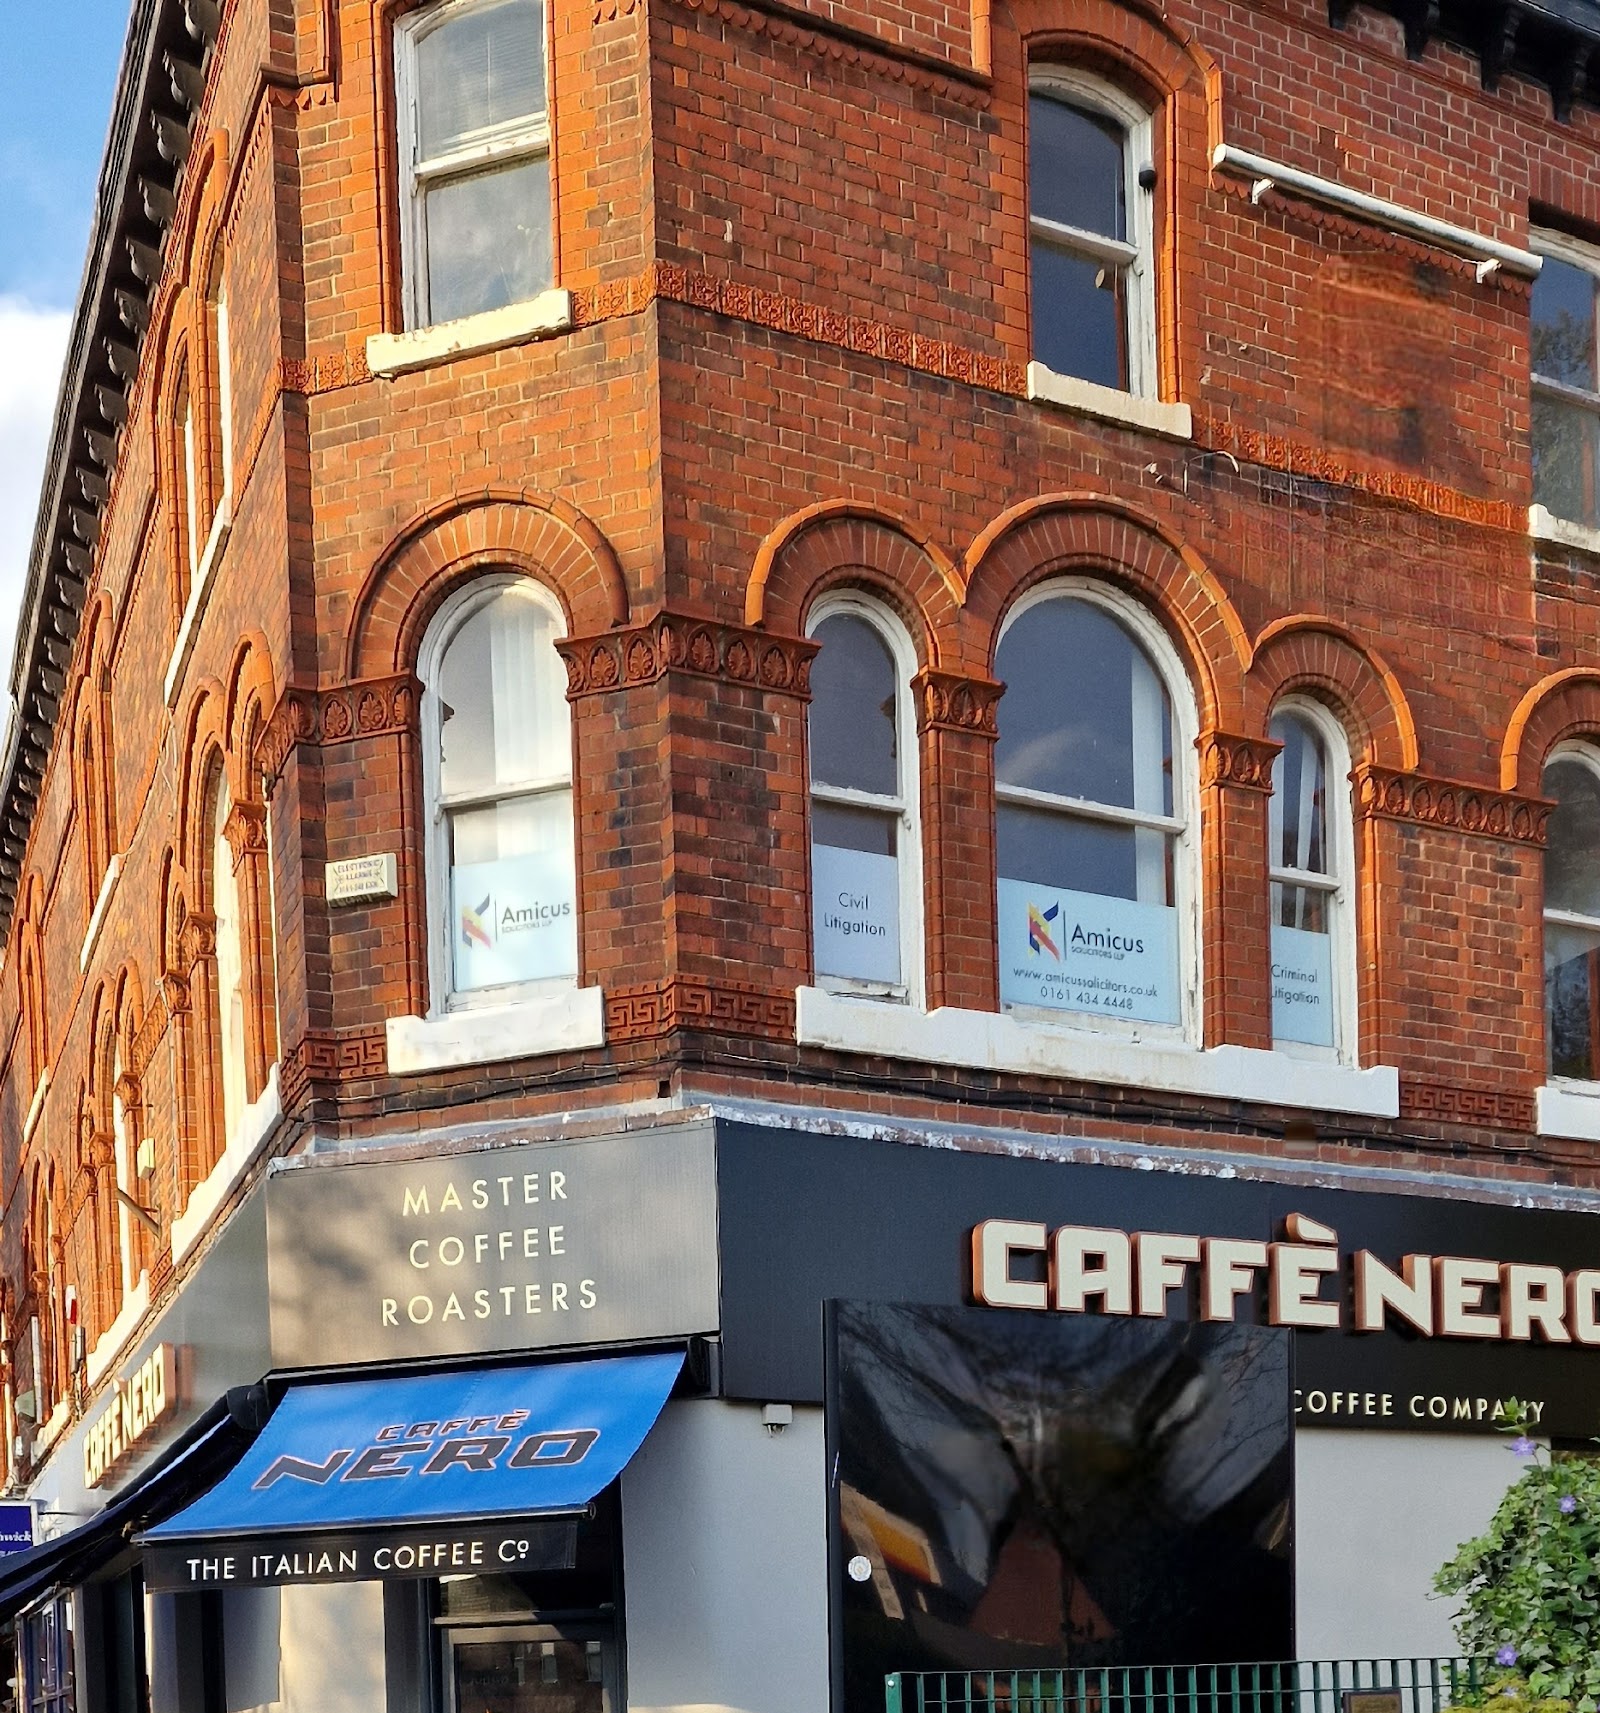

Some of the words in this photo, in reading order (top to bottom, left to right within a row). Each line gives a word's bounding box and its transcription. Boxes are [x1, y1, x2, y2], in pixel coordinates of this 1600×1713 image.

[501, 901, 570, 925] Amicus
[838, 892, 869, 910] Civil
[824, 912, 886, 937] Litigation
[1071, 923, 1145, 953] Amicus
[1013, 967, 1158, 997] www.amicussolicitors.co.uk
[1270, 964, 1318, 983] Criminal
[1040, 986, 1071, 1000] 0161
[1076, 992, 1099, 1005] 434
[1103, 995, 1134, 1010] 4448
[402, 1171, 568, 1217] MASTER
[409, 1225, 566, 1269] COFFEE
[973, 1211, 1340, 1328] CAFFÈ
[382, 1279, 597, 1327] ROASTERS
[121, 1342, 174, 1451] NERO
[376, 1408, 531, 1442] CAFFÈ
[251, 1429, 601, 1491] NERO
[187, 1558, 236, 1580] THE
[251, 1549, 358, 1578] ITALIAN
[374, 1541, 483, 1570] COFFEE
